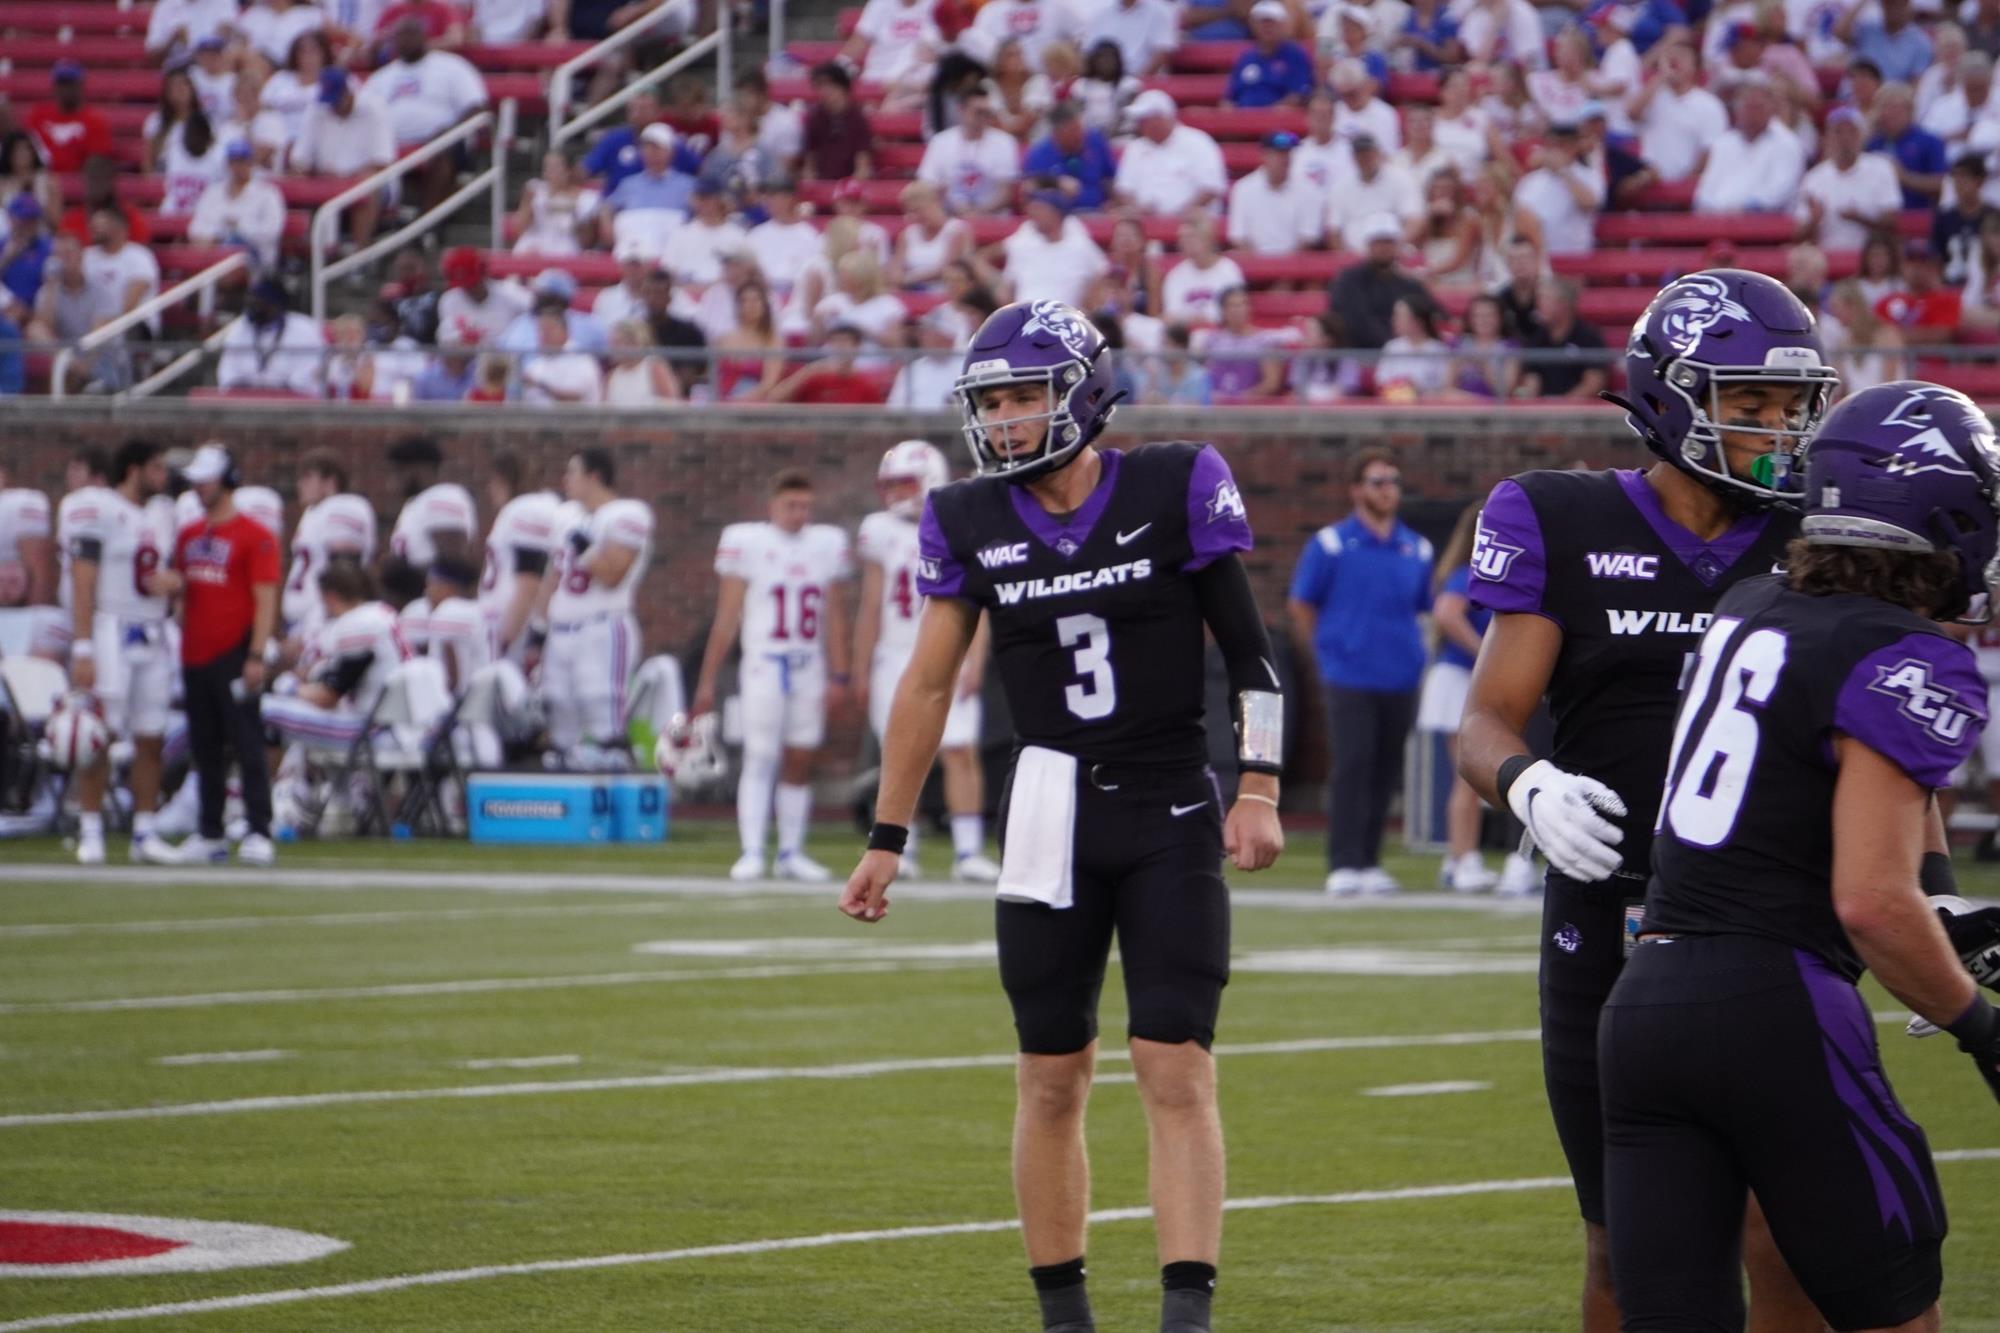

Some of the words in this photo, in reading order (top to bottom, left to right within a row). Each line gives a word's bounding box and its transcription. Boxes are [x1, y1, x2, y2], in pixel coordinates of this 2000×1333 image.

[977, 542, 1029, 568] WAC
[1472, 516, 1511, 576] CU
[1587, 553, 1659, 578] WAC
[993, 558, 1152, 604] WILDCATS
[770, 584, 824, 641] 16
[1606, 609, 1714, 635] WILD
[1055, 612, 1117, 720] 3
[1881, 665, 1973, 740] ACU
[1653, 617, 1788, 847] 16
[1552, 931, 1578, 952] ACU
